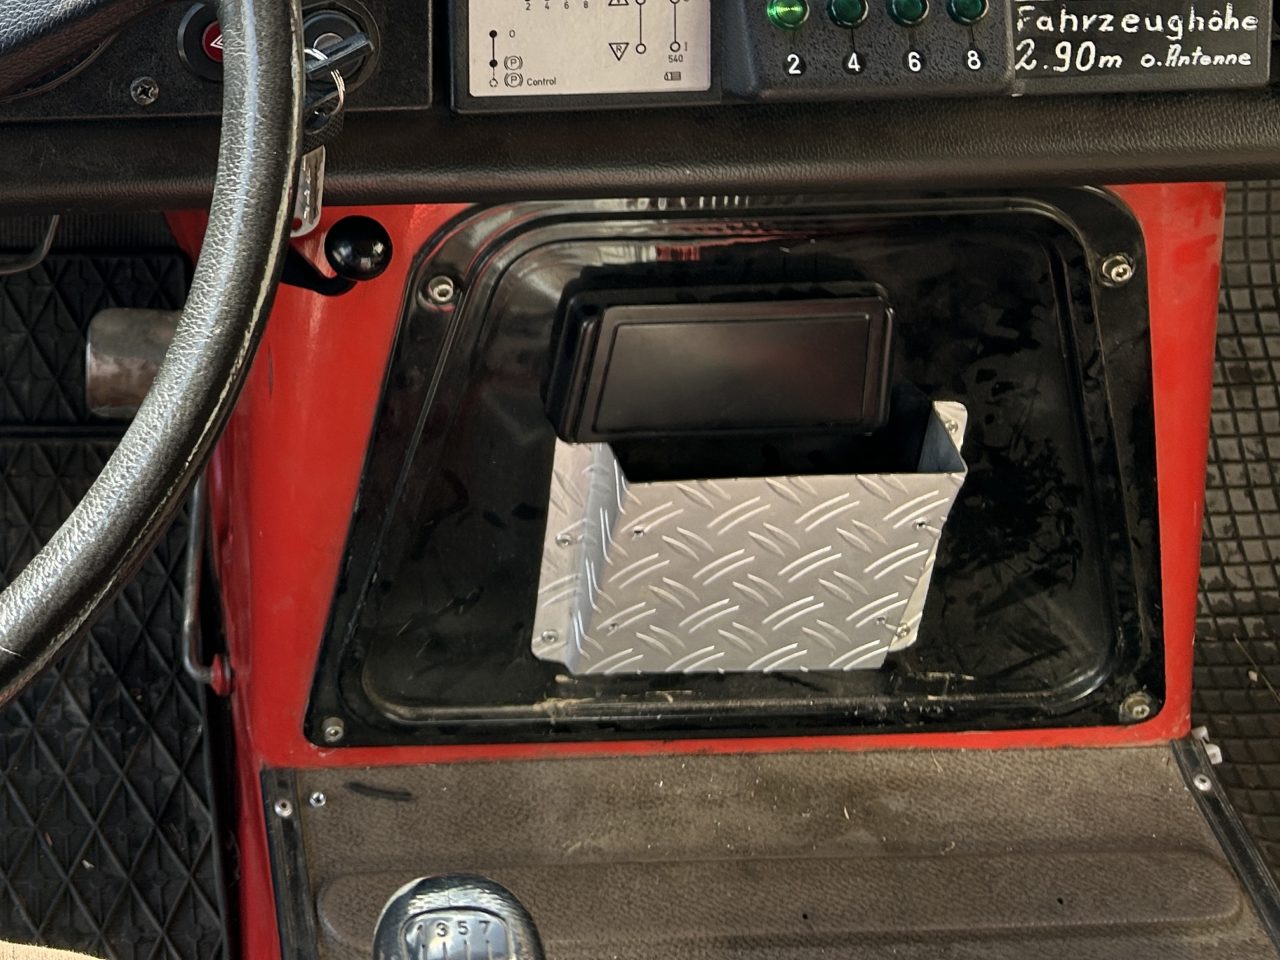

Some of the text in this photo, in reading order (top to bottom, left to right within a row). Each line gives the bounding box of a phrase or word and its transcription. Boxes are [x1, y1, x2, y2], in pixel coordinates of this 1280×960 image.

[526, 1, 589, 11] 2 4 6 8
[668, 54, 684, 63] 540
[787, 50, 981, 75] 2 4 6 8
[526, 77, 557, 87] Control
[436, 922, 448, 937] 3
[457, 920, 469, 935] 5
[478, 920, 490, 935] 7
